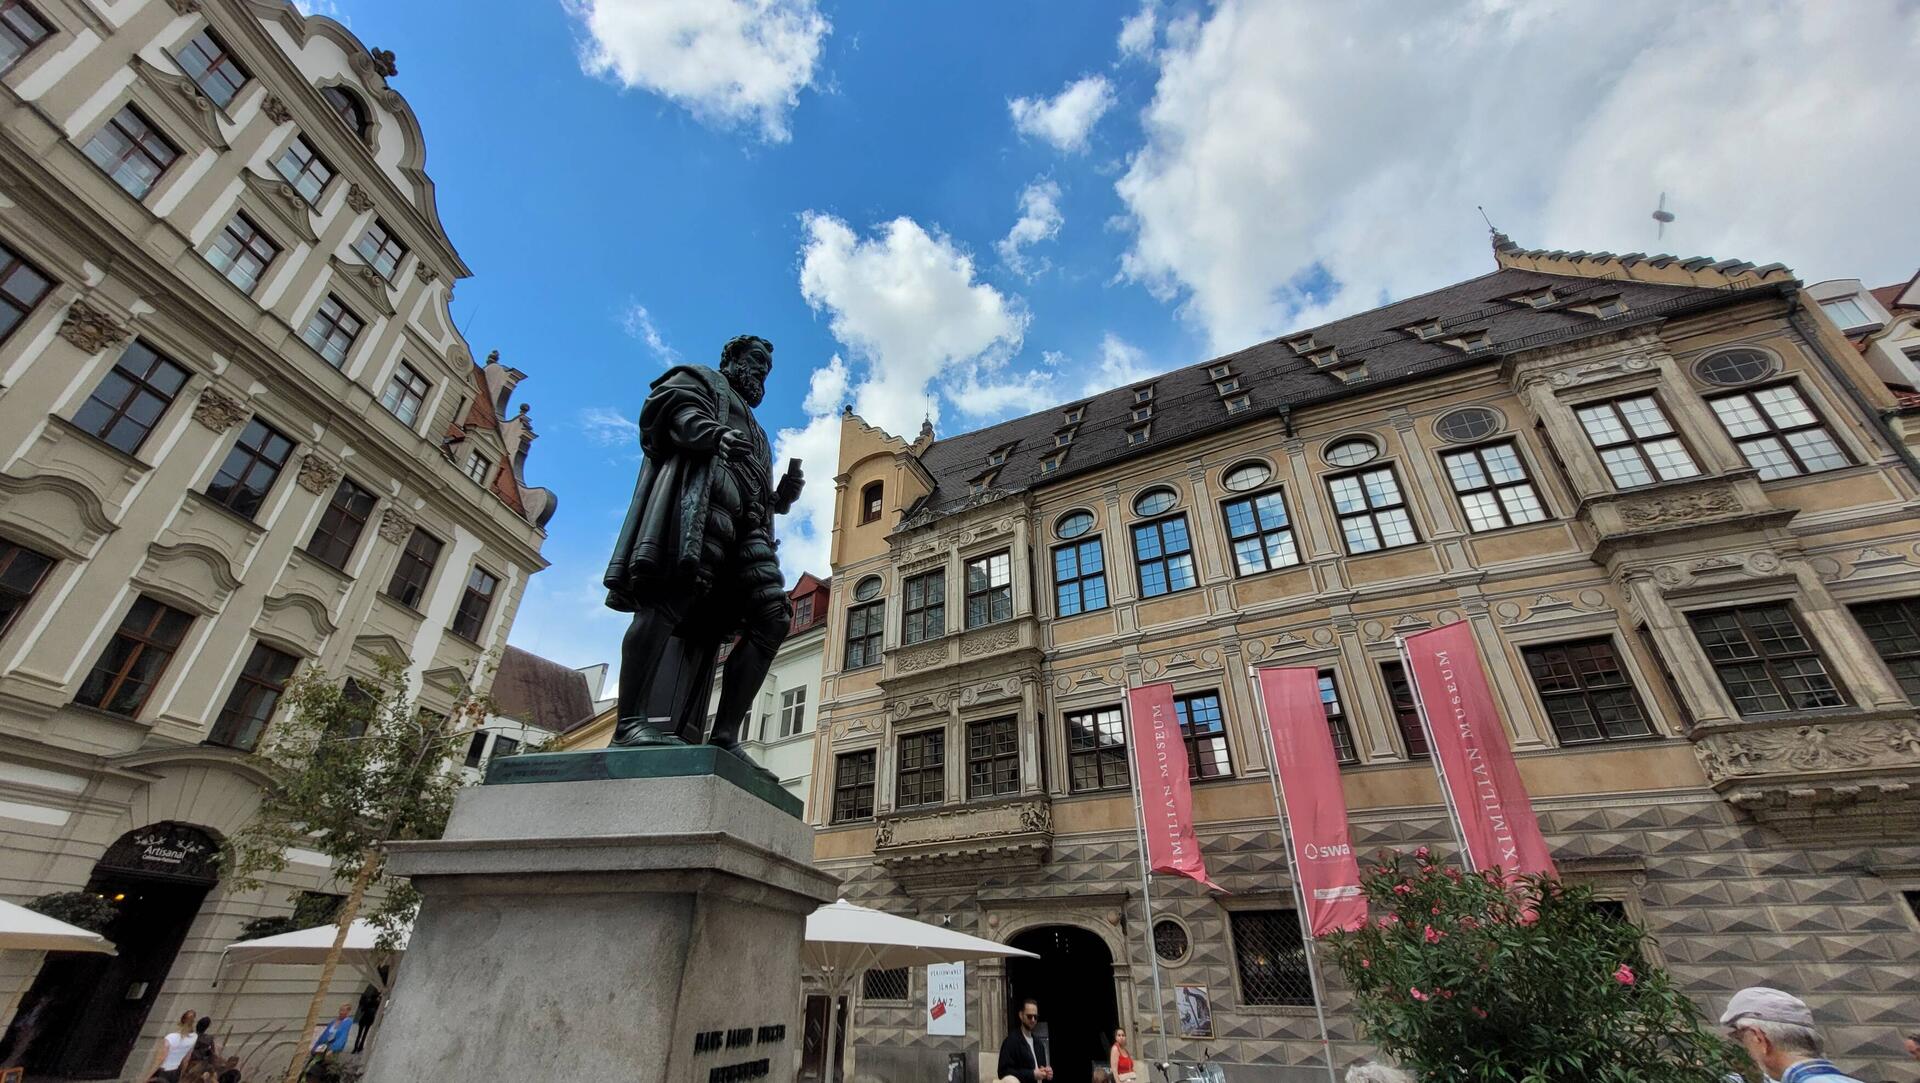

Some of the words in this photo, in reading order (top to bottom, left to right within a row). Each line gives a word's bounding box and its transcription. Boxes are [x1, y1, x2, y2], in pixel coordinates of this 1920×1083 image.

[1434, 650, 1474, 738] MUSEUM
[1152, 704, 1169, 777] MUSEUM
[143, 845, 187, 860] Artisanal
[1164, 785, 1183, 867] IMILIAN
[1319, 843, 1350, 858] swa
